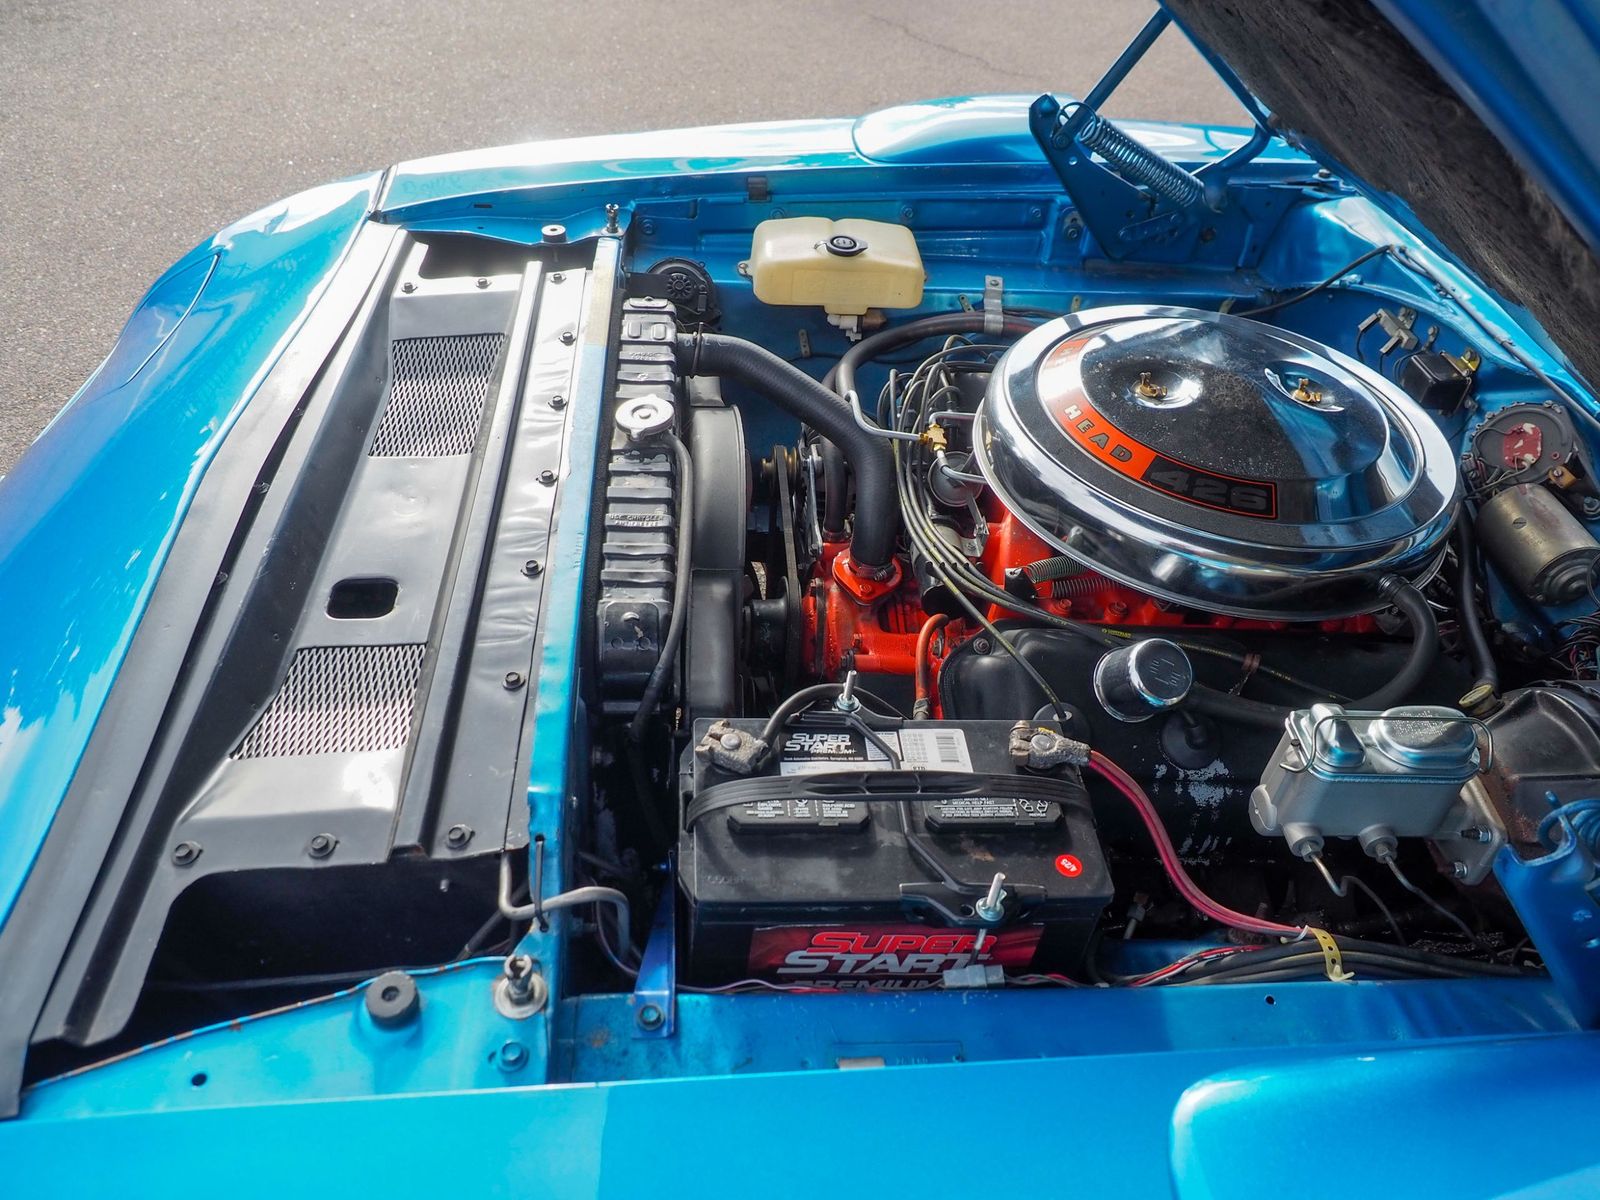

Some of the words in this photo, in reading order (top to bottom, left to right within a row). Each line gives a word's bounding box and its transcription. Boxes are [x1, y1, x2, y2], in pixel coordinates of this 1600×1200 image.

[1064, 404, 1133, 463] HEAD
[1150, 470, 1268, 511] 426
[784, 740, 852, 752] START
[792, 733, 851, 742] SUPER
[806, 931, 998, 954] SUPER
[776, 950, 992, 974] START
